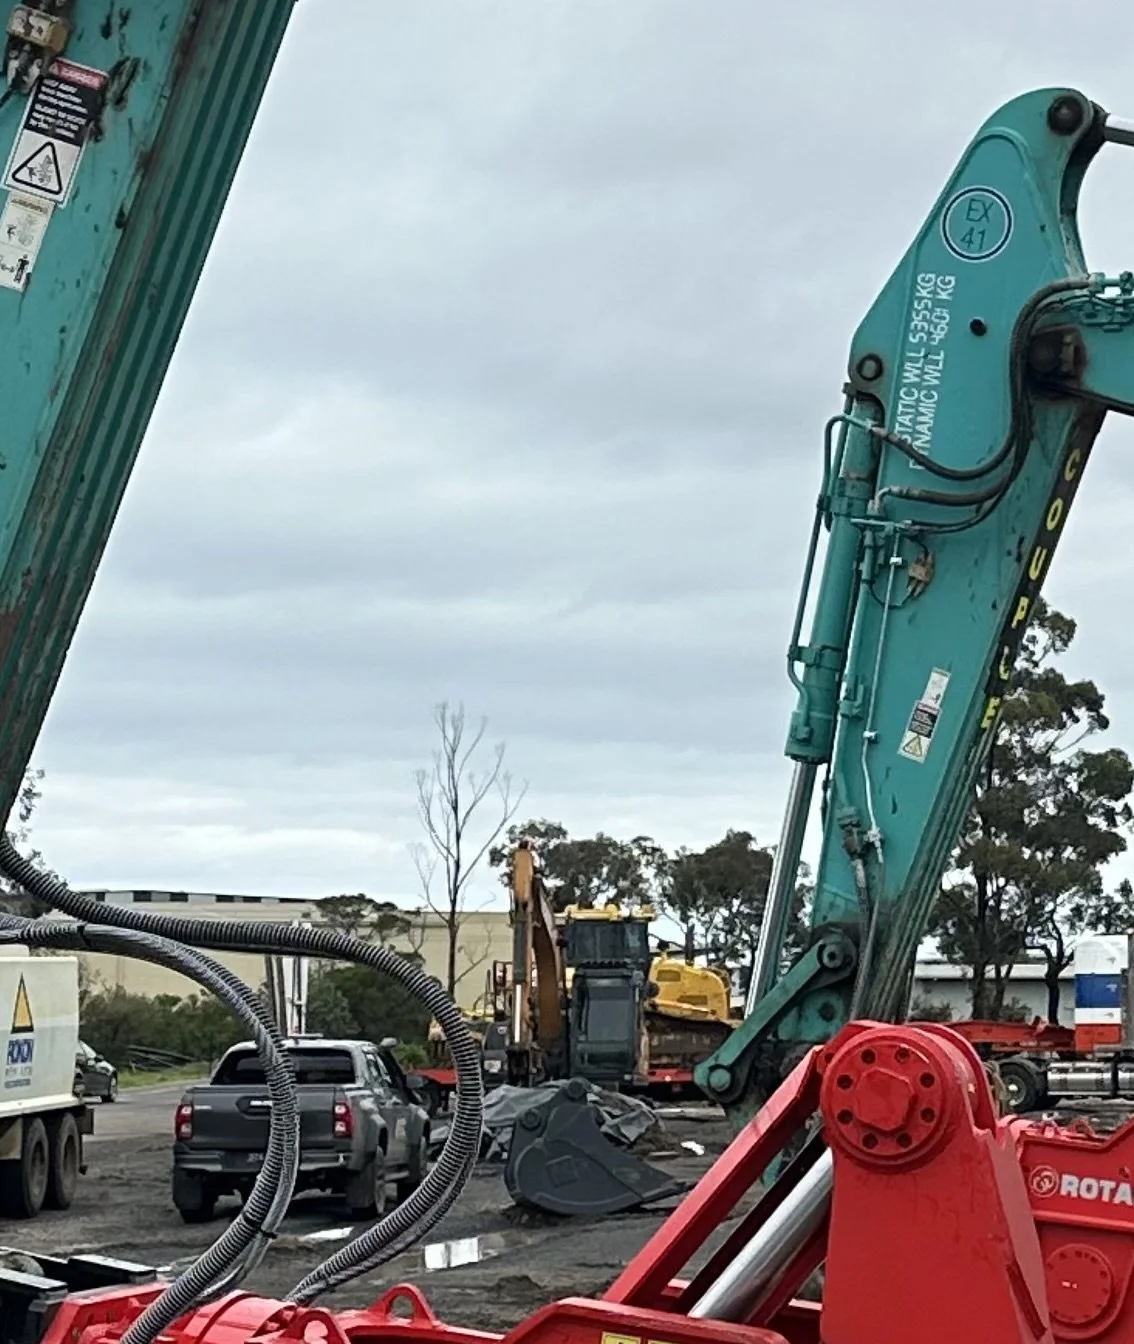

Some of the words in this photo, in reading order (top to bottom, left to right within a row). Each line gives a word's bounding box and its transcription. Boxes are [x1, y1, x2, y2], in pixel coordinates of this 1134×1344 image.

[965, 198, 995, 224] EX
[960, 227, 986, 251] 41
[922, 349, 945, 386] WLL
[935, 275, 957, 301] KG
[902, 347, 926, 384] WLL
